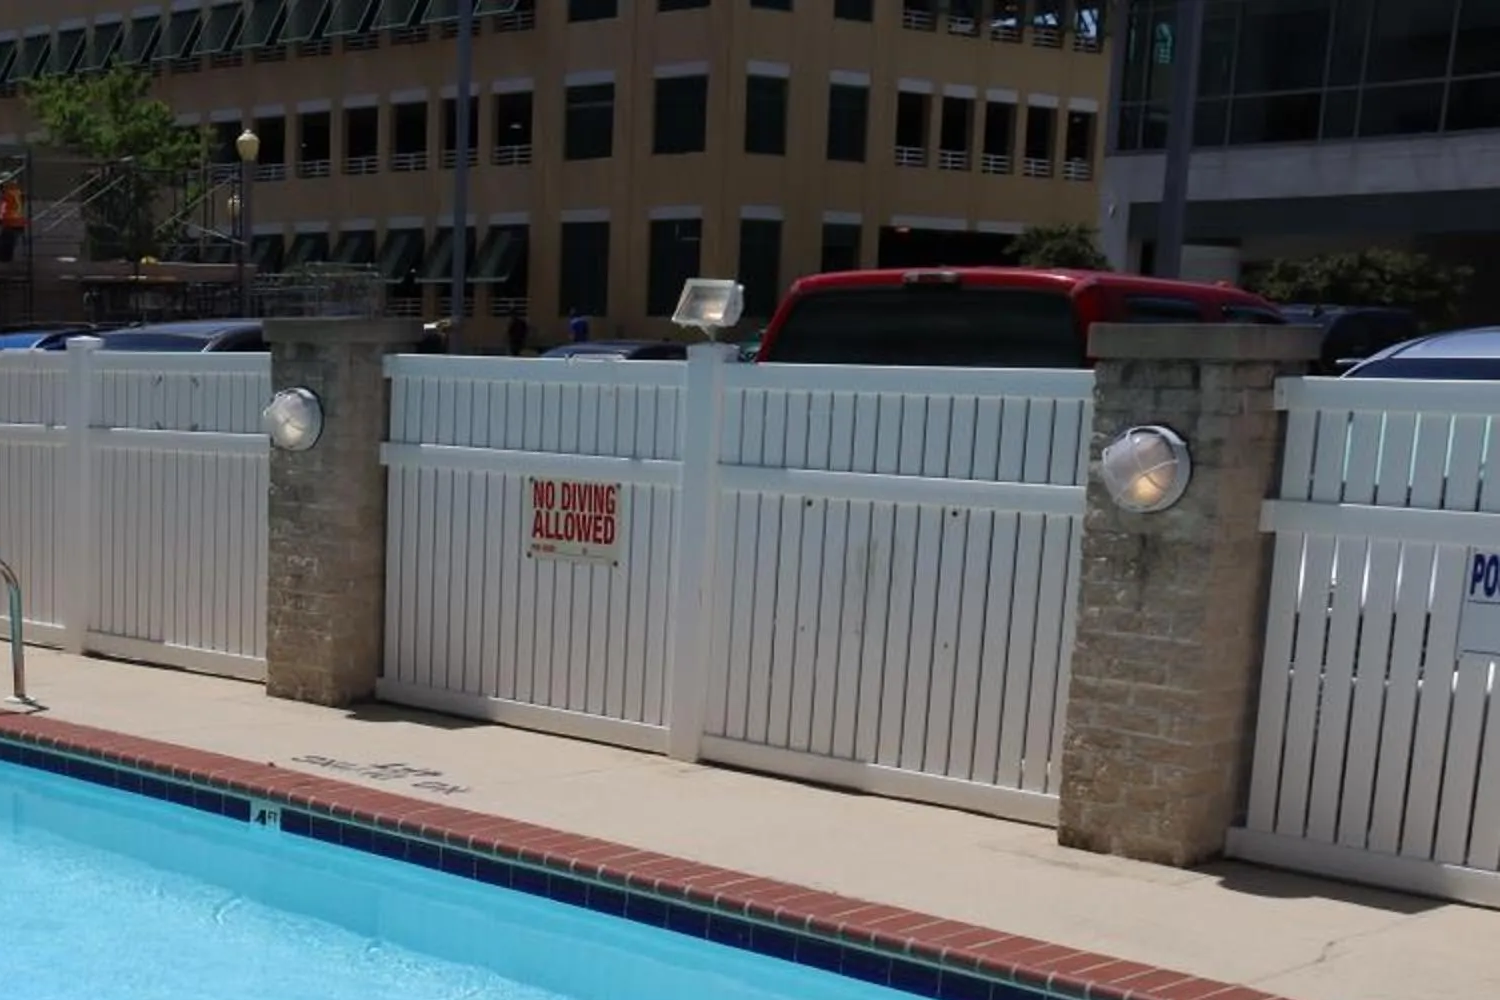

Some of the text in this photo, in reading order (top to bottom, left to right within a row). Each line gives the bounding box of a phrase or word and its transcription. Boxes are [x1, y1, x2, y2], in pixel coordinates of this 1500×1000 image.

[533, 480, 615, 514] NO DIVING
[532, 509, 615, 545] ALLOWED
[1470, 553, 1500, 597] PO
